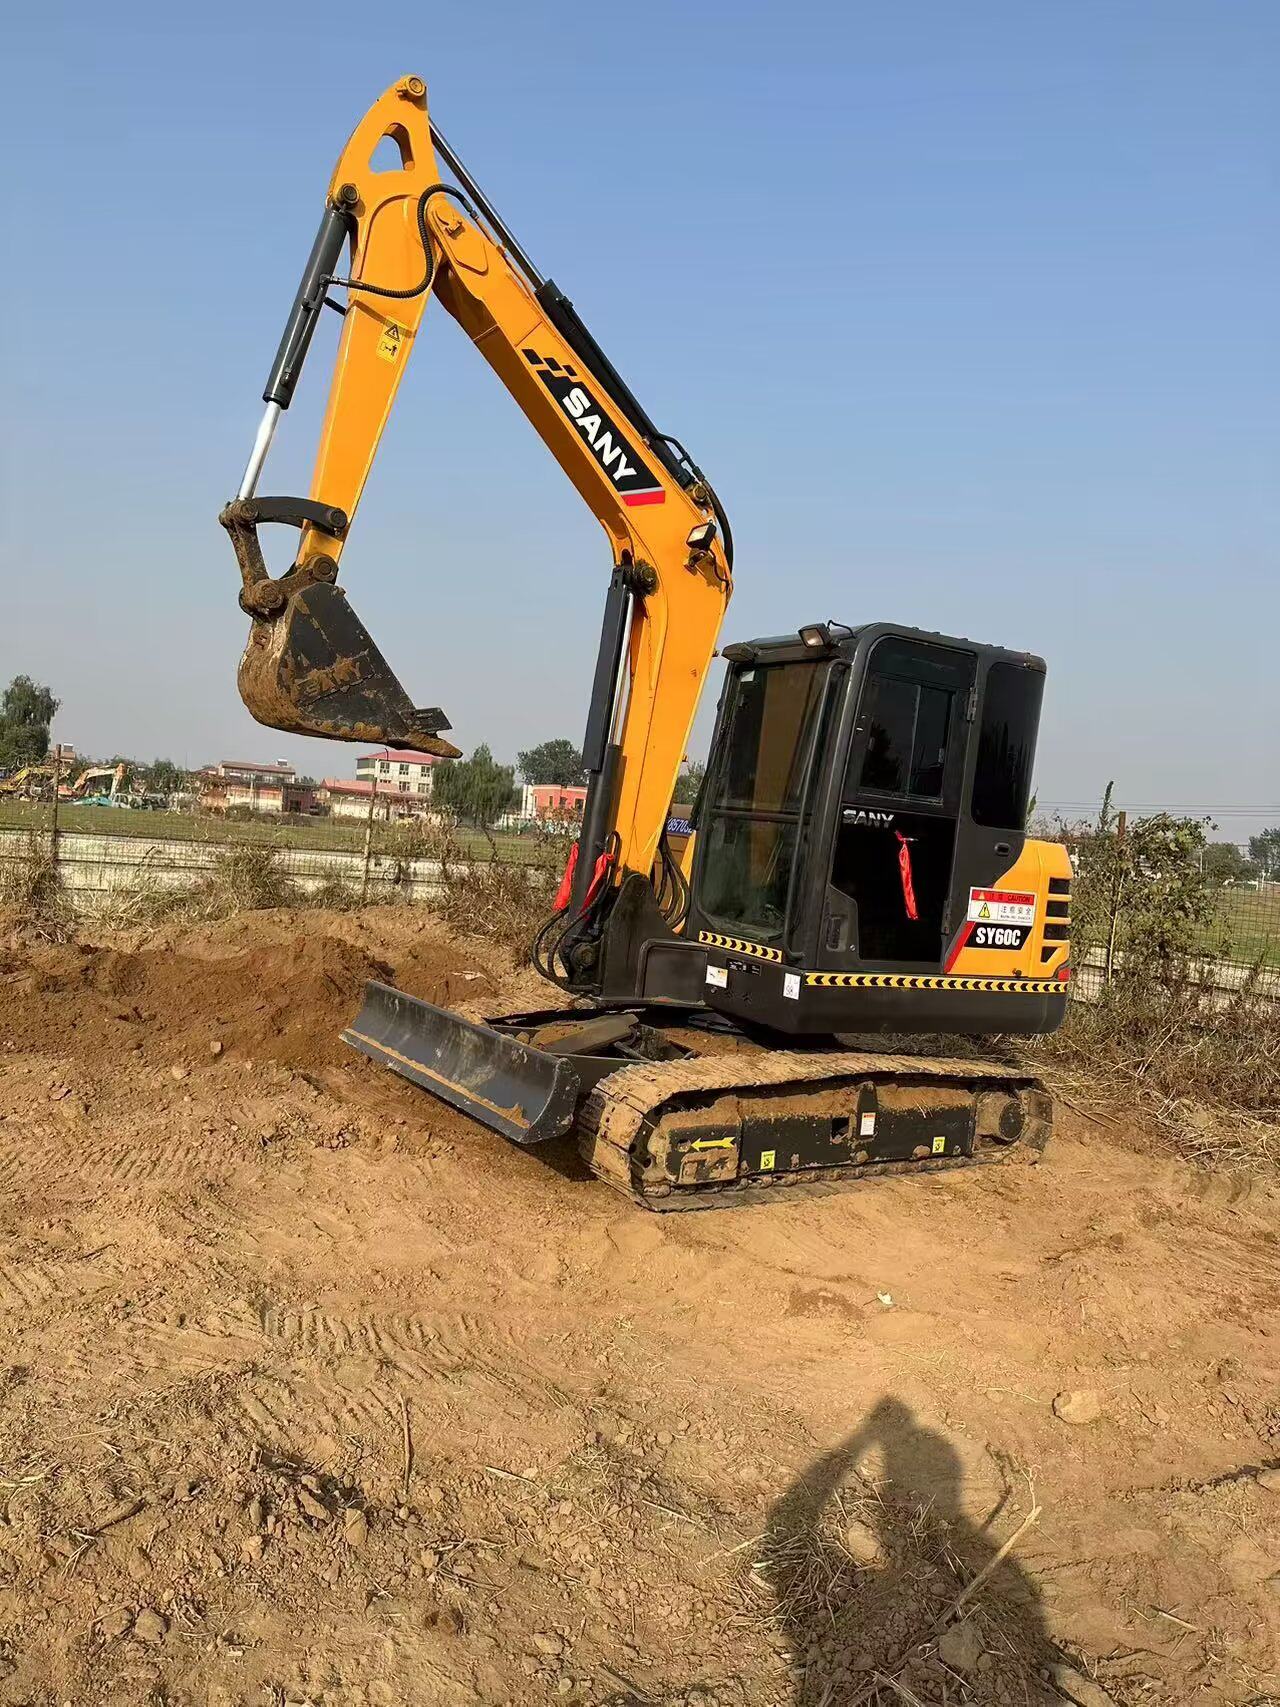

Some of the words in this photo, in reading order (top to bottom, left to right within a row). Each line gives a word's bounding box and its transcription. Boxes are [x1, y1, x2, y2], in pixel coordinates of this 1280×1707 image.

[562, 387, 637, 481] SANY
[843, 809, 894, 828] SANY
[1007, 894, 1031, 902] CAUTION
[975, 927, 1021, 946] SY60C
